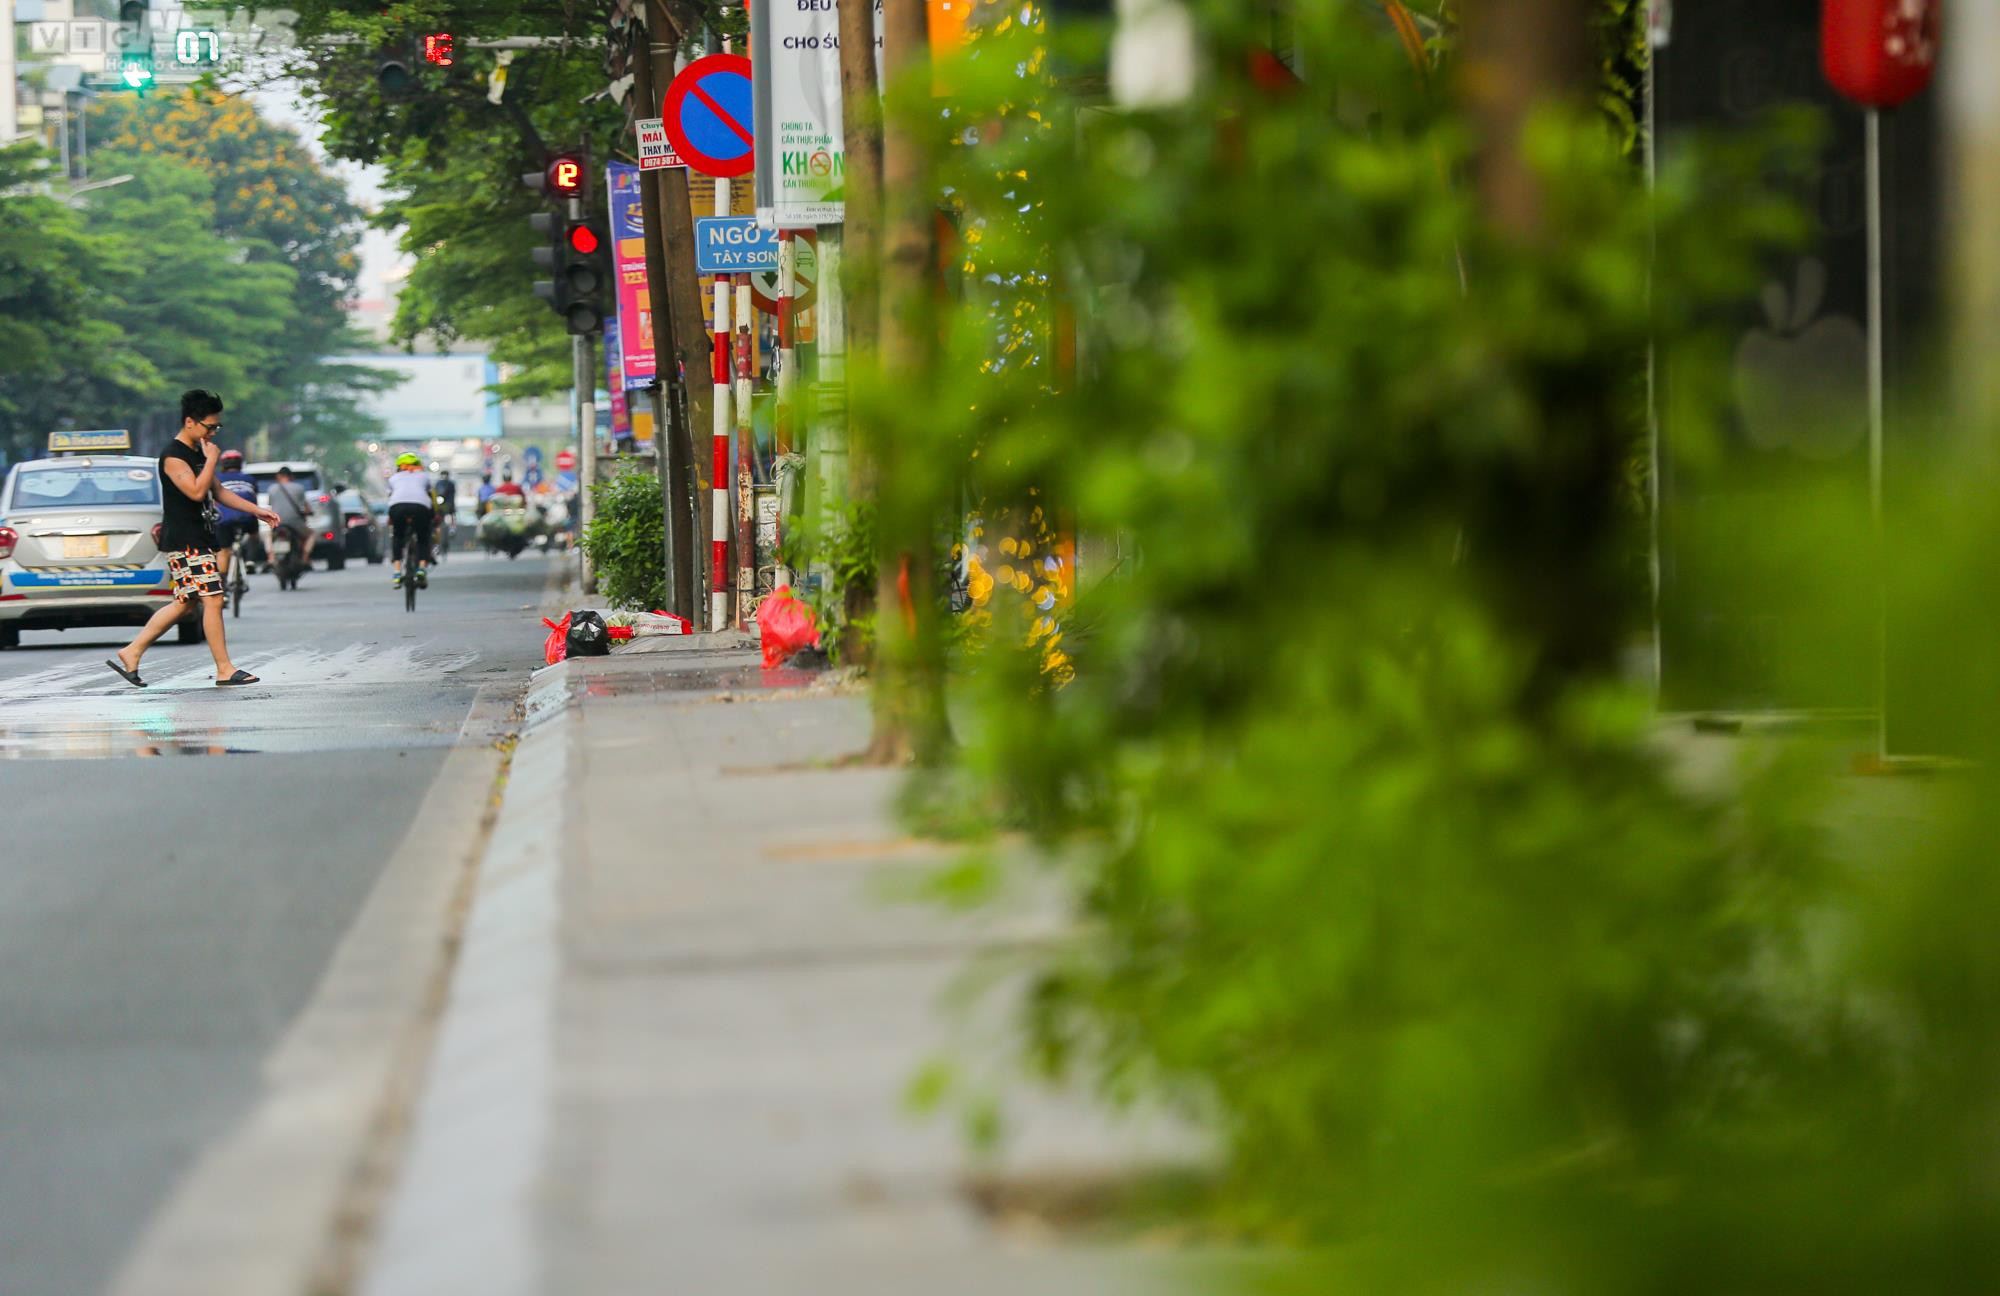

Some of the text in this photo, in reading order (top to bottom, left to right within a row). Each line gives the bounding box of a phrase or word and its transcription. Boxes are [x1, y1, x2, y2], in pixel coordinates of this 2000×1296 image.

[783, 36, 819, 49] CHO
[642, 145, 661, 155] THAY
[712, 249, 778, 264] TÂY SƠN
